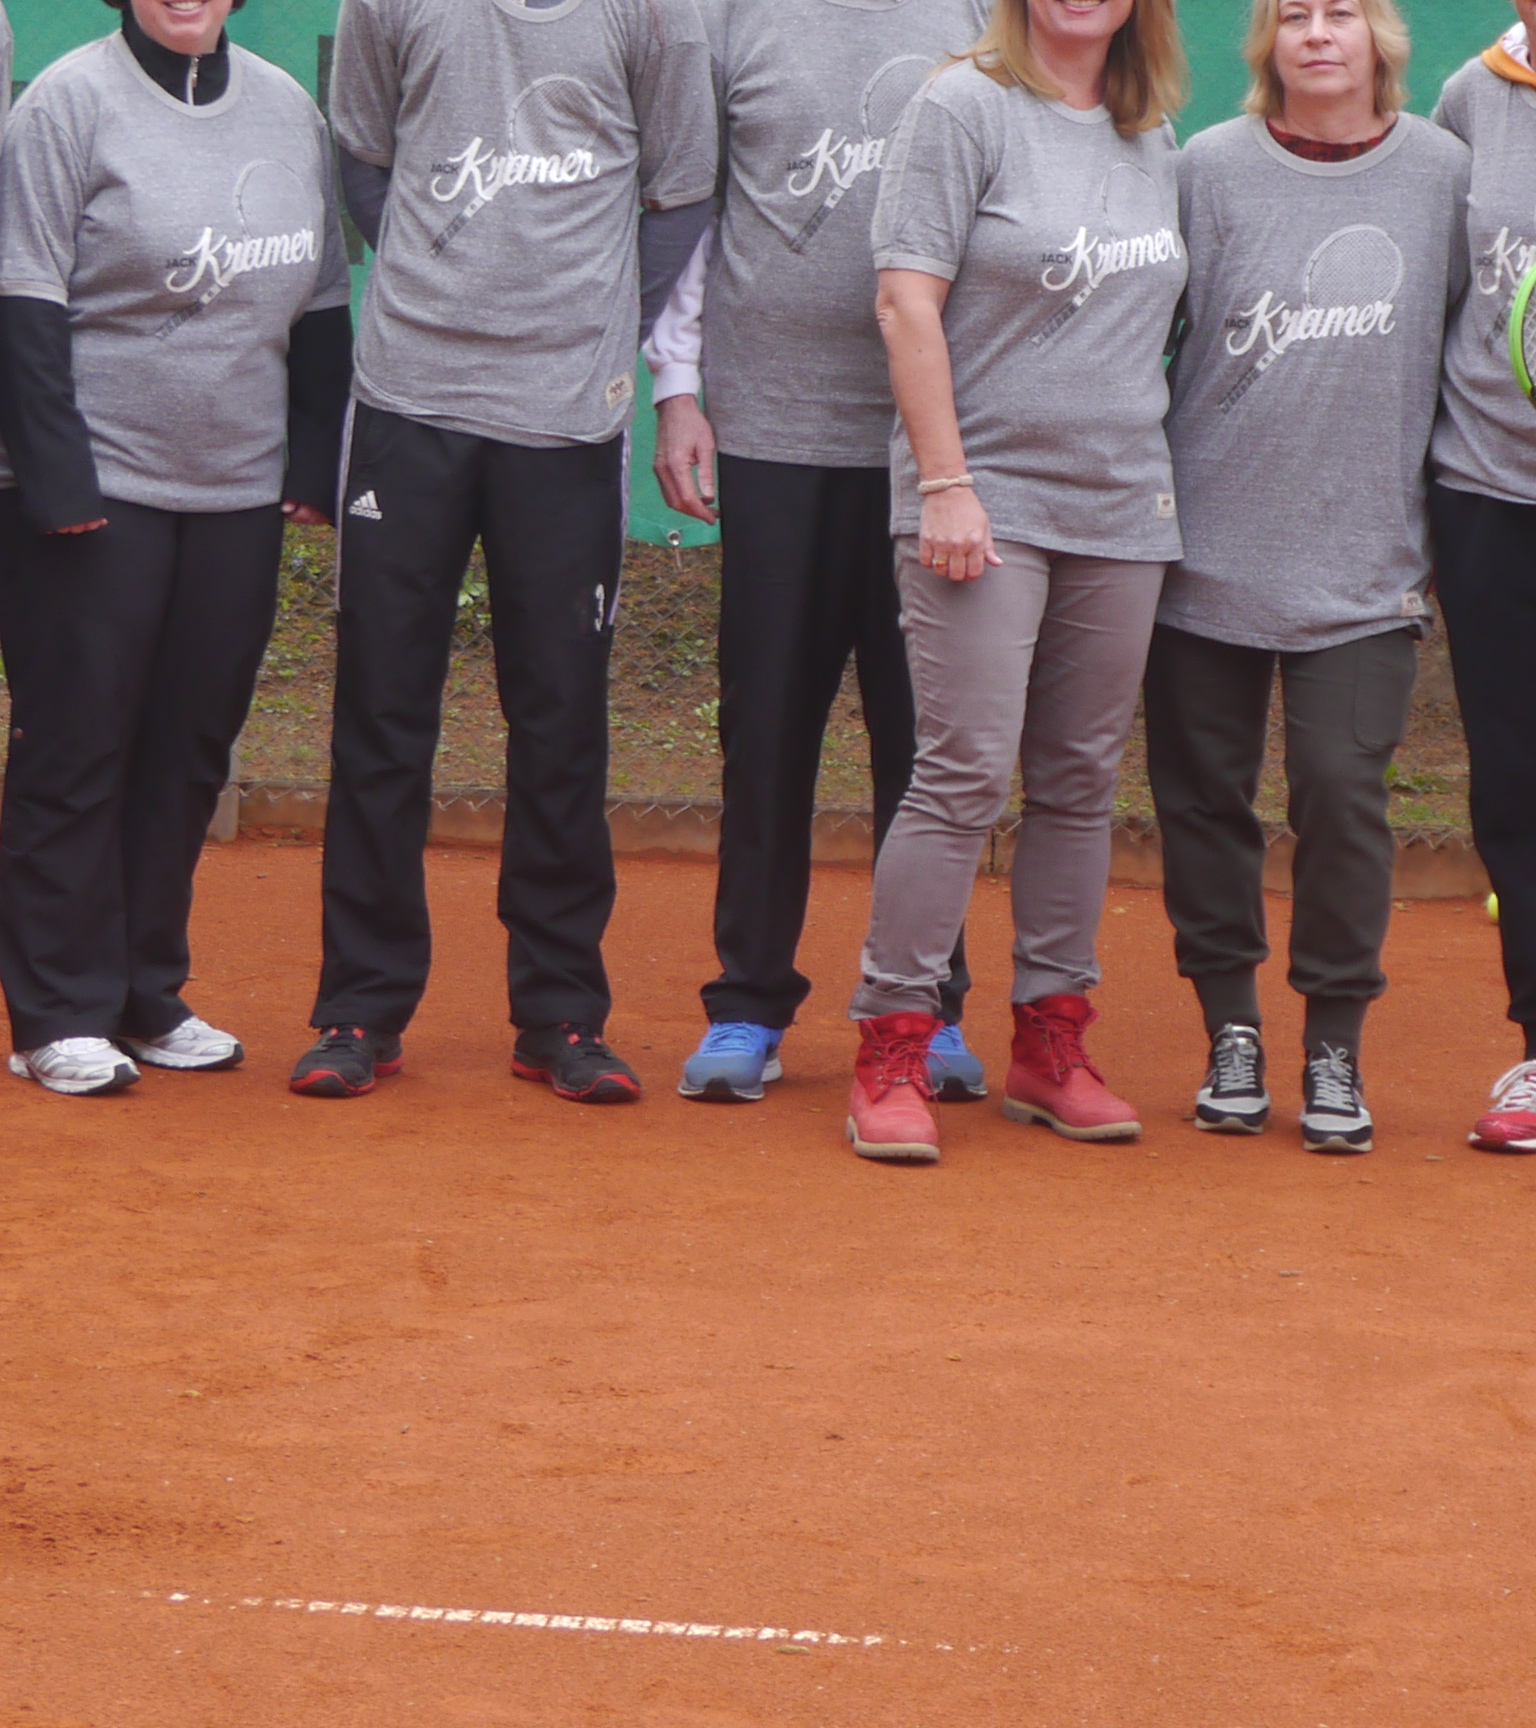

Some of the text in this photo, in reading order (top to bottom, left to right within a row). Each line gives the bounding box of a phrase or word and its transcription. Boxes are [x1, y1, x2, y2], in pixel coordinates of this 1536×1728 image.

[430, 135, 601, 203] Kramer
[787, 127, 887, 198] Kra
[165, 225, 320, 295] Kramer
[1040, 224, 1182, 292] JACK Kramer
[1225, 289, 1397, 356] Kramer
